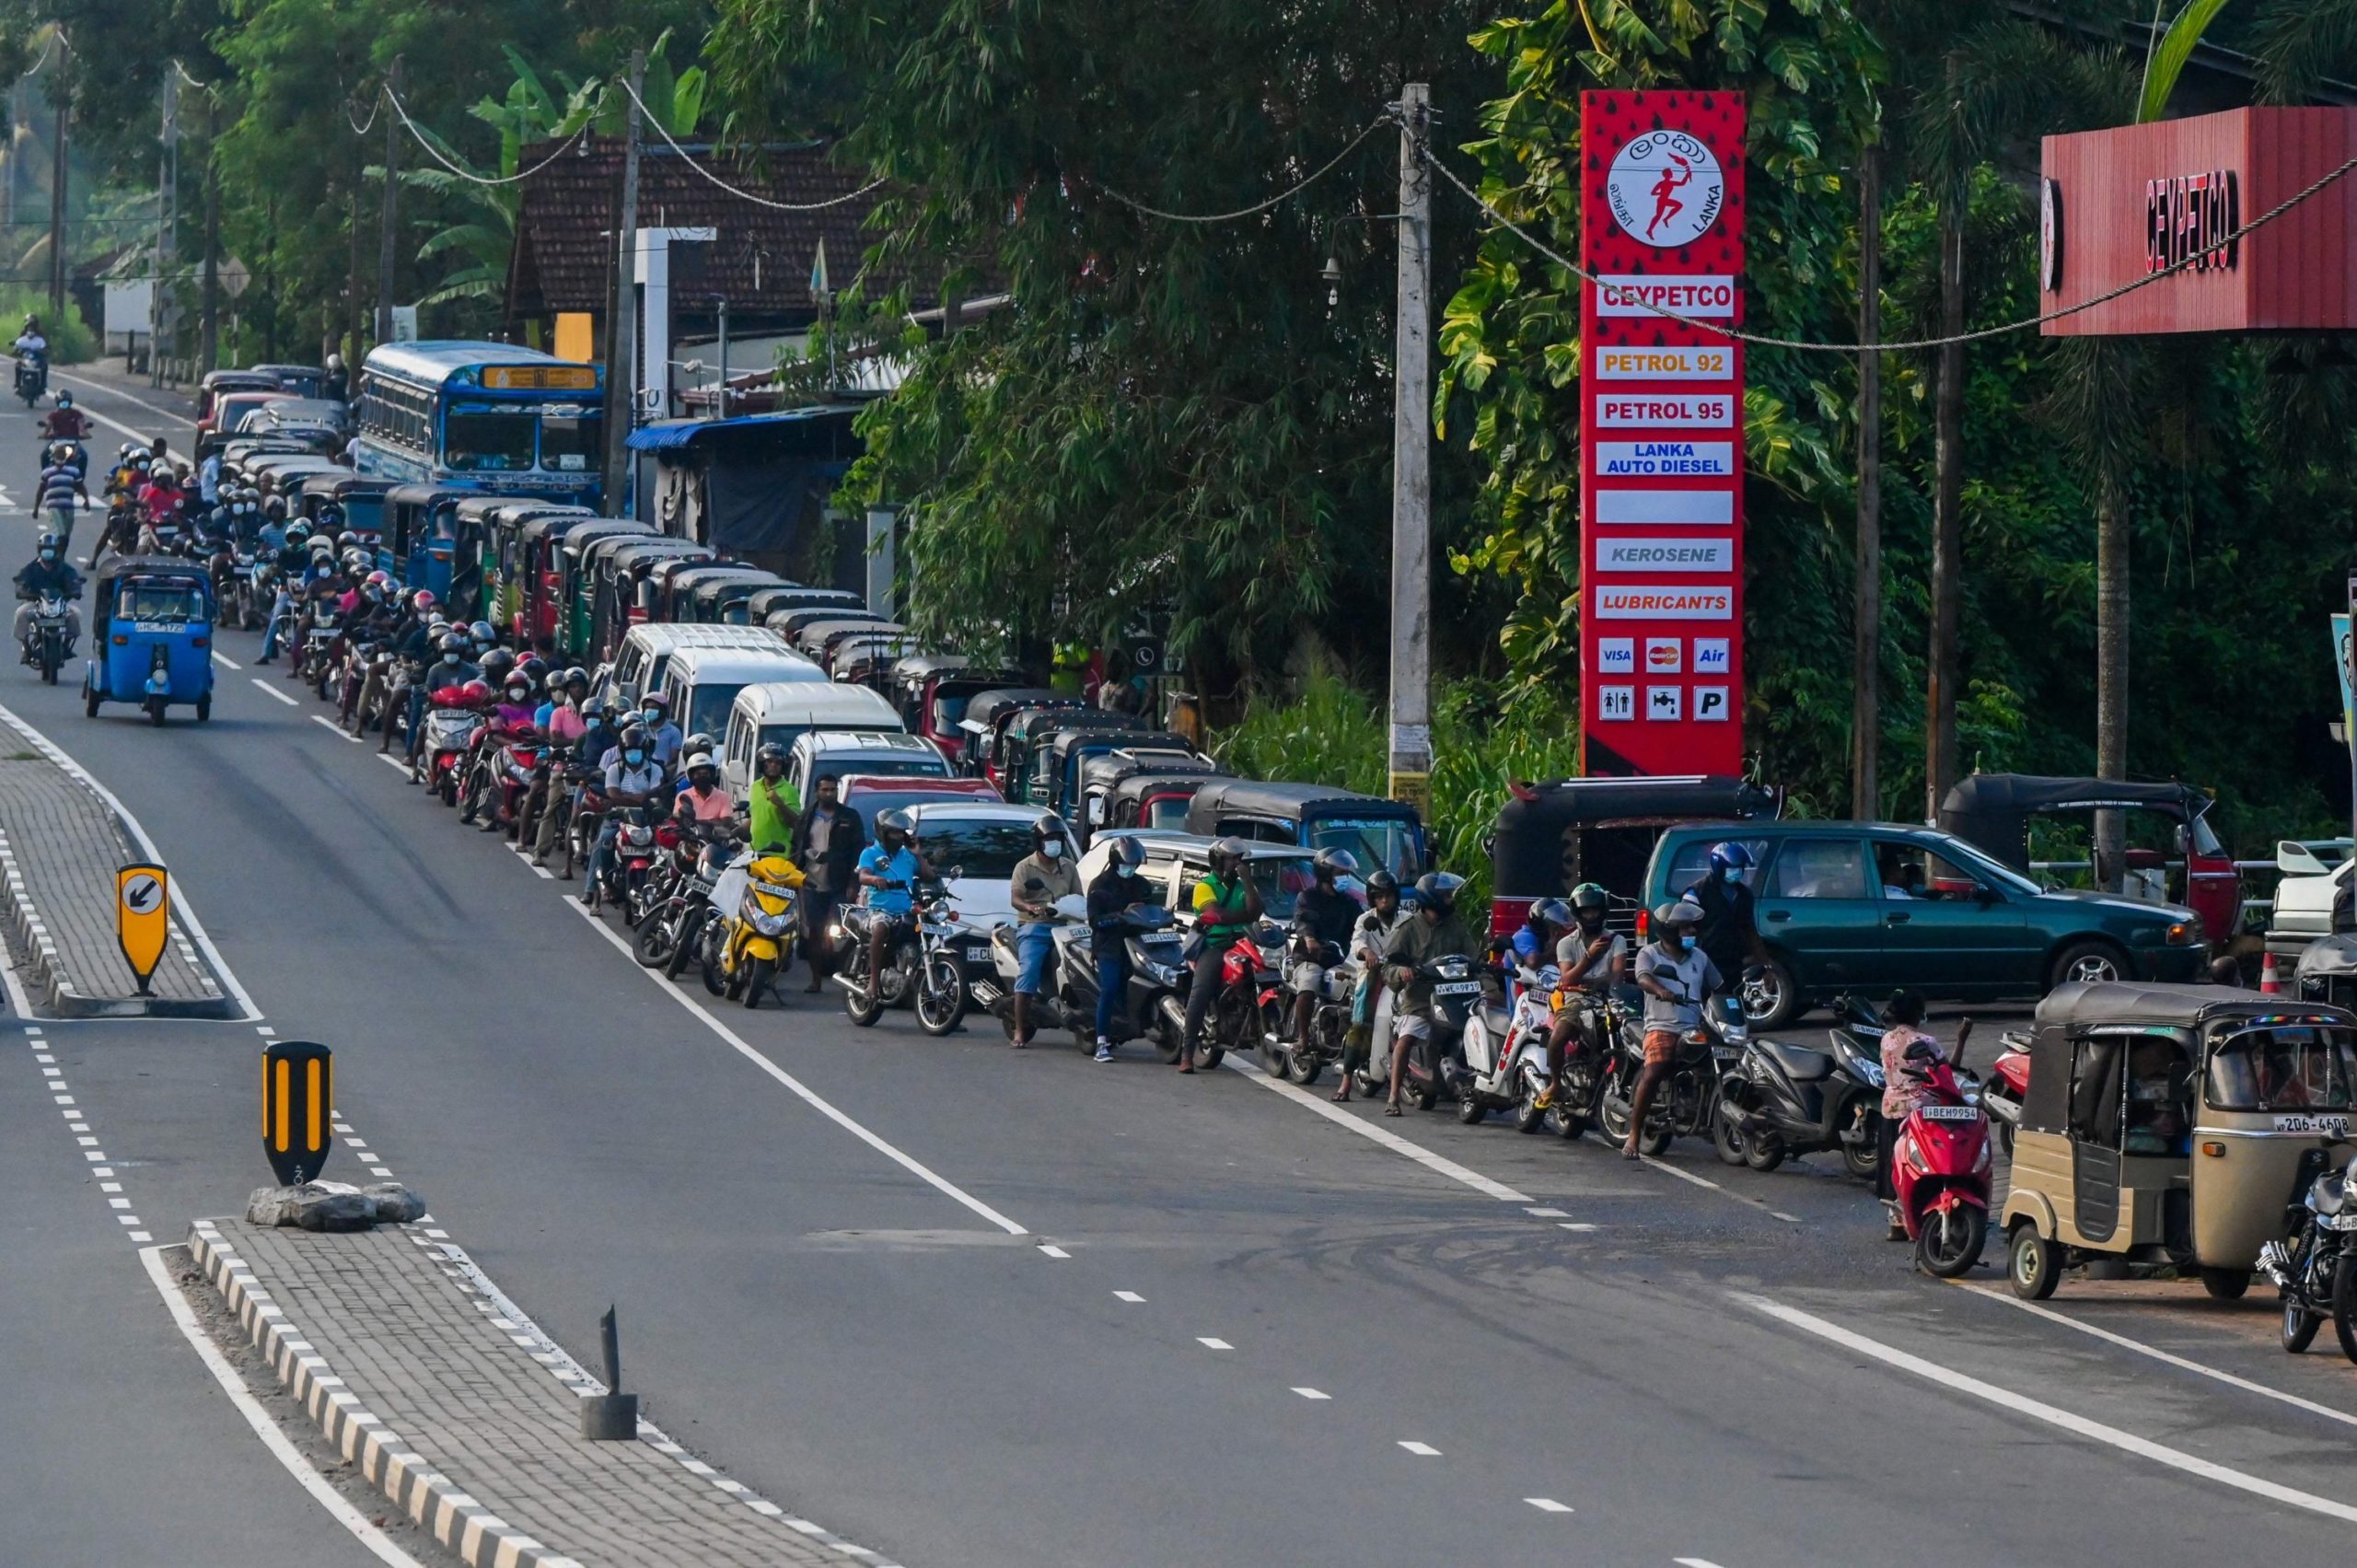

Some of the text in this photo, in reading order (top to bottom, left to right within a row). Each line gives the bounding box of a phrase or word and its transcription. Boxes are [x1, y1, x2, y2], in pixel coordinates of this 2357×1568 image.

[1691, 184, 1721, 233] LANKA
[2144, 169, 2229, 274] CEYPETCO
[1603, 285, 1731, 307] CEYPETCO
[1605, 354, 1723, 372] PETROL 92
[1605, 402, 1724, 420] PETROL 95
[1634, 444, 1695, 457] LANKA
[1607, 459, 1724, 473] AUTO DIESEL
[1611, 548, 1717, 563] KEROSENE
[1603, 595, 1727, 610] LUBRICANTS
[1604, 650, 1631, 661] VISA
[1700, 649, 1725, 662] Air
[1701, 692, 1722, 714] P
